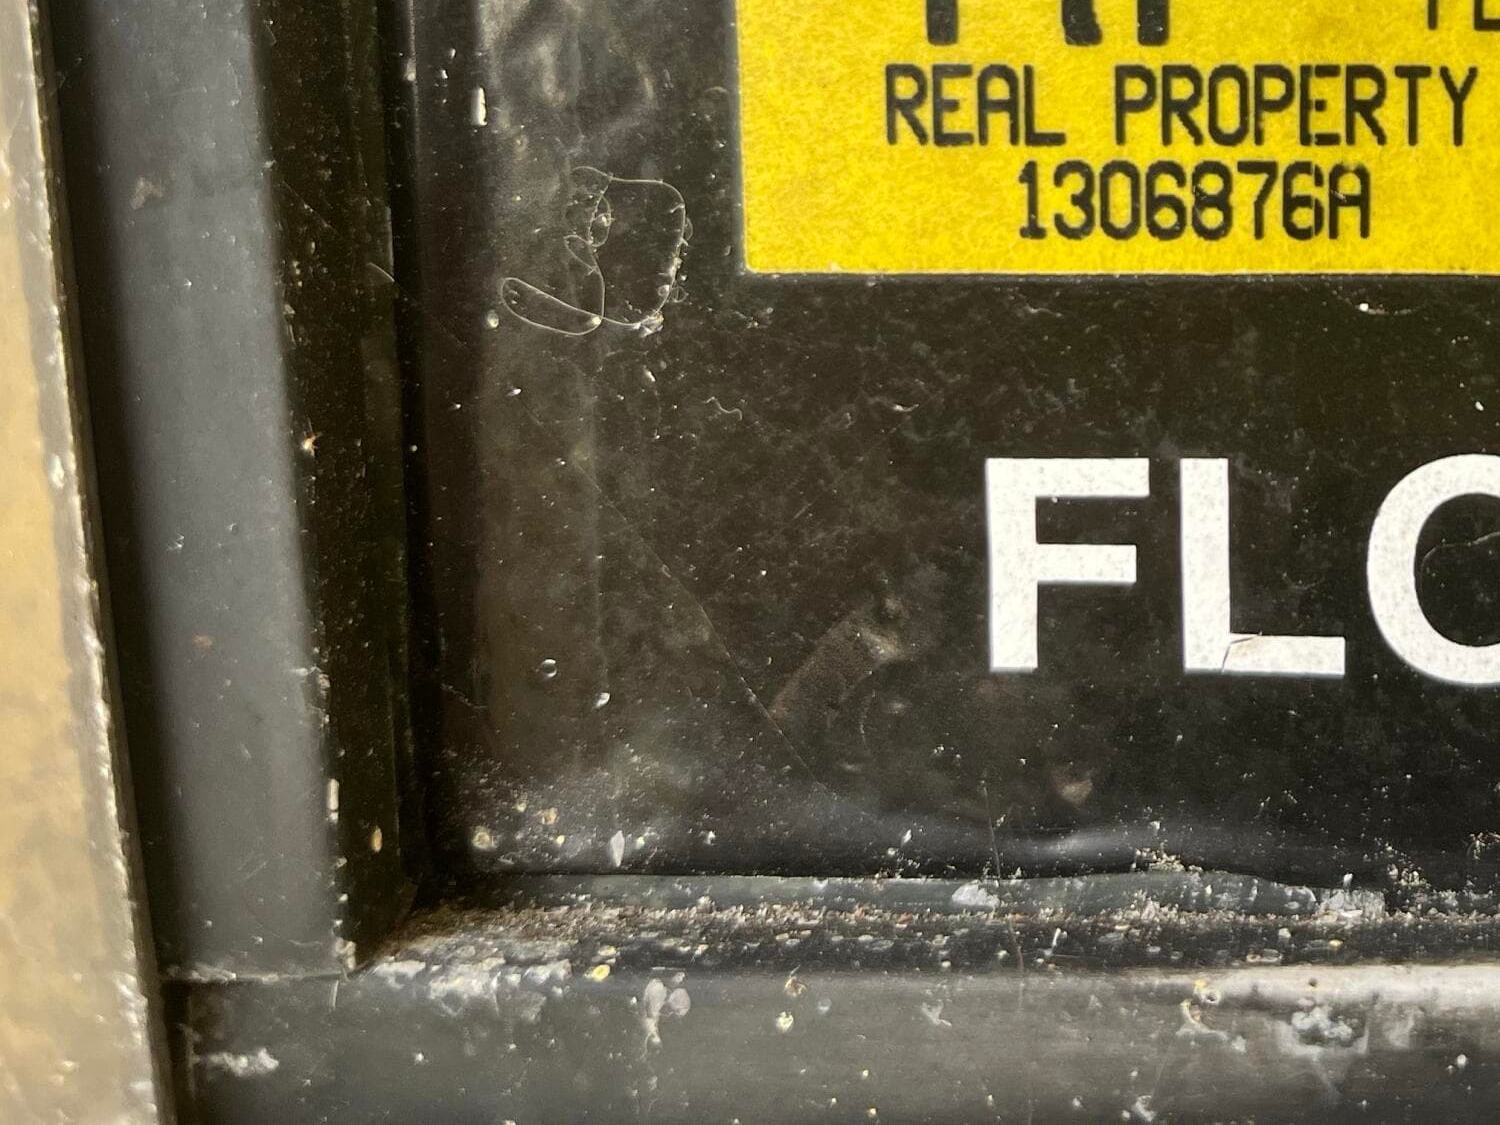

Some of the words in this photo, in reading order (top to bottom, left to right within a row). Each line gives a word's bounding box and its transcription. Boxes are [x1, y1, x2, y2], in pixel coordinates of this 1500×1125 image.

[885, 64, 1066, 147] REAL
[1114, 64, 1478, 147] PROPERTY
[1019, 160, 1371, 241] 1306876A
